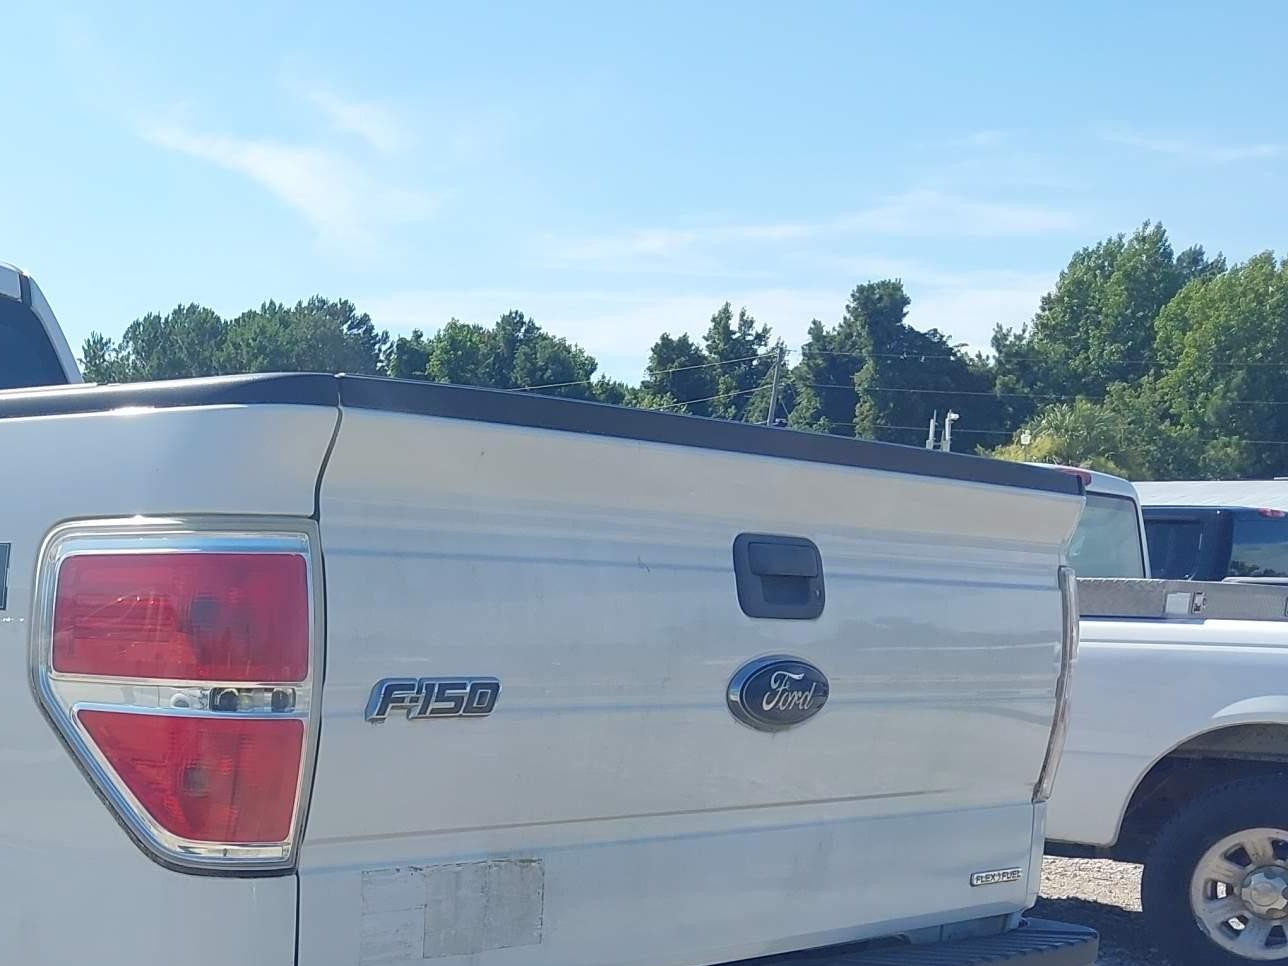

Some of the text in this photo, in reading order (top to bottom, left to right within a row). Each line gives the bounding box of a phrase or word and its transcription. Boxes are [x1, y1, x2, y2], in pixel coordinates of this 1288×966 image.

[365, 677, 500, 721] F-150
[763, 671, 817, 711] Ford
[975, 869, 1022, 884] FLEX FUEL
